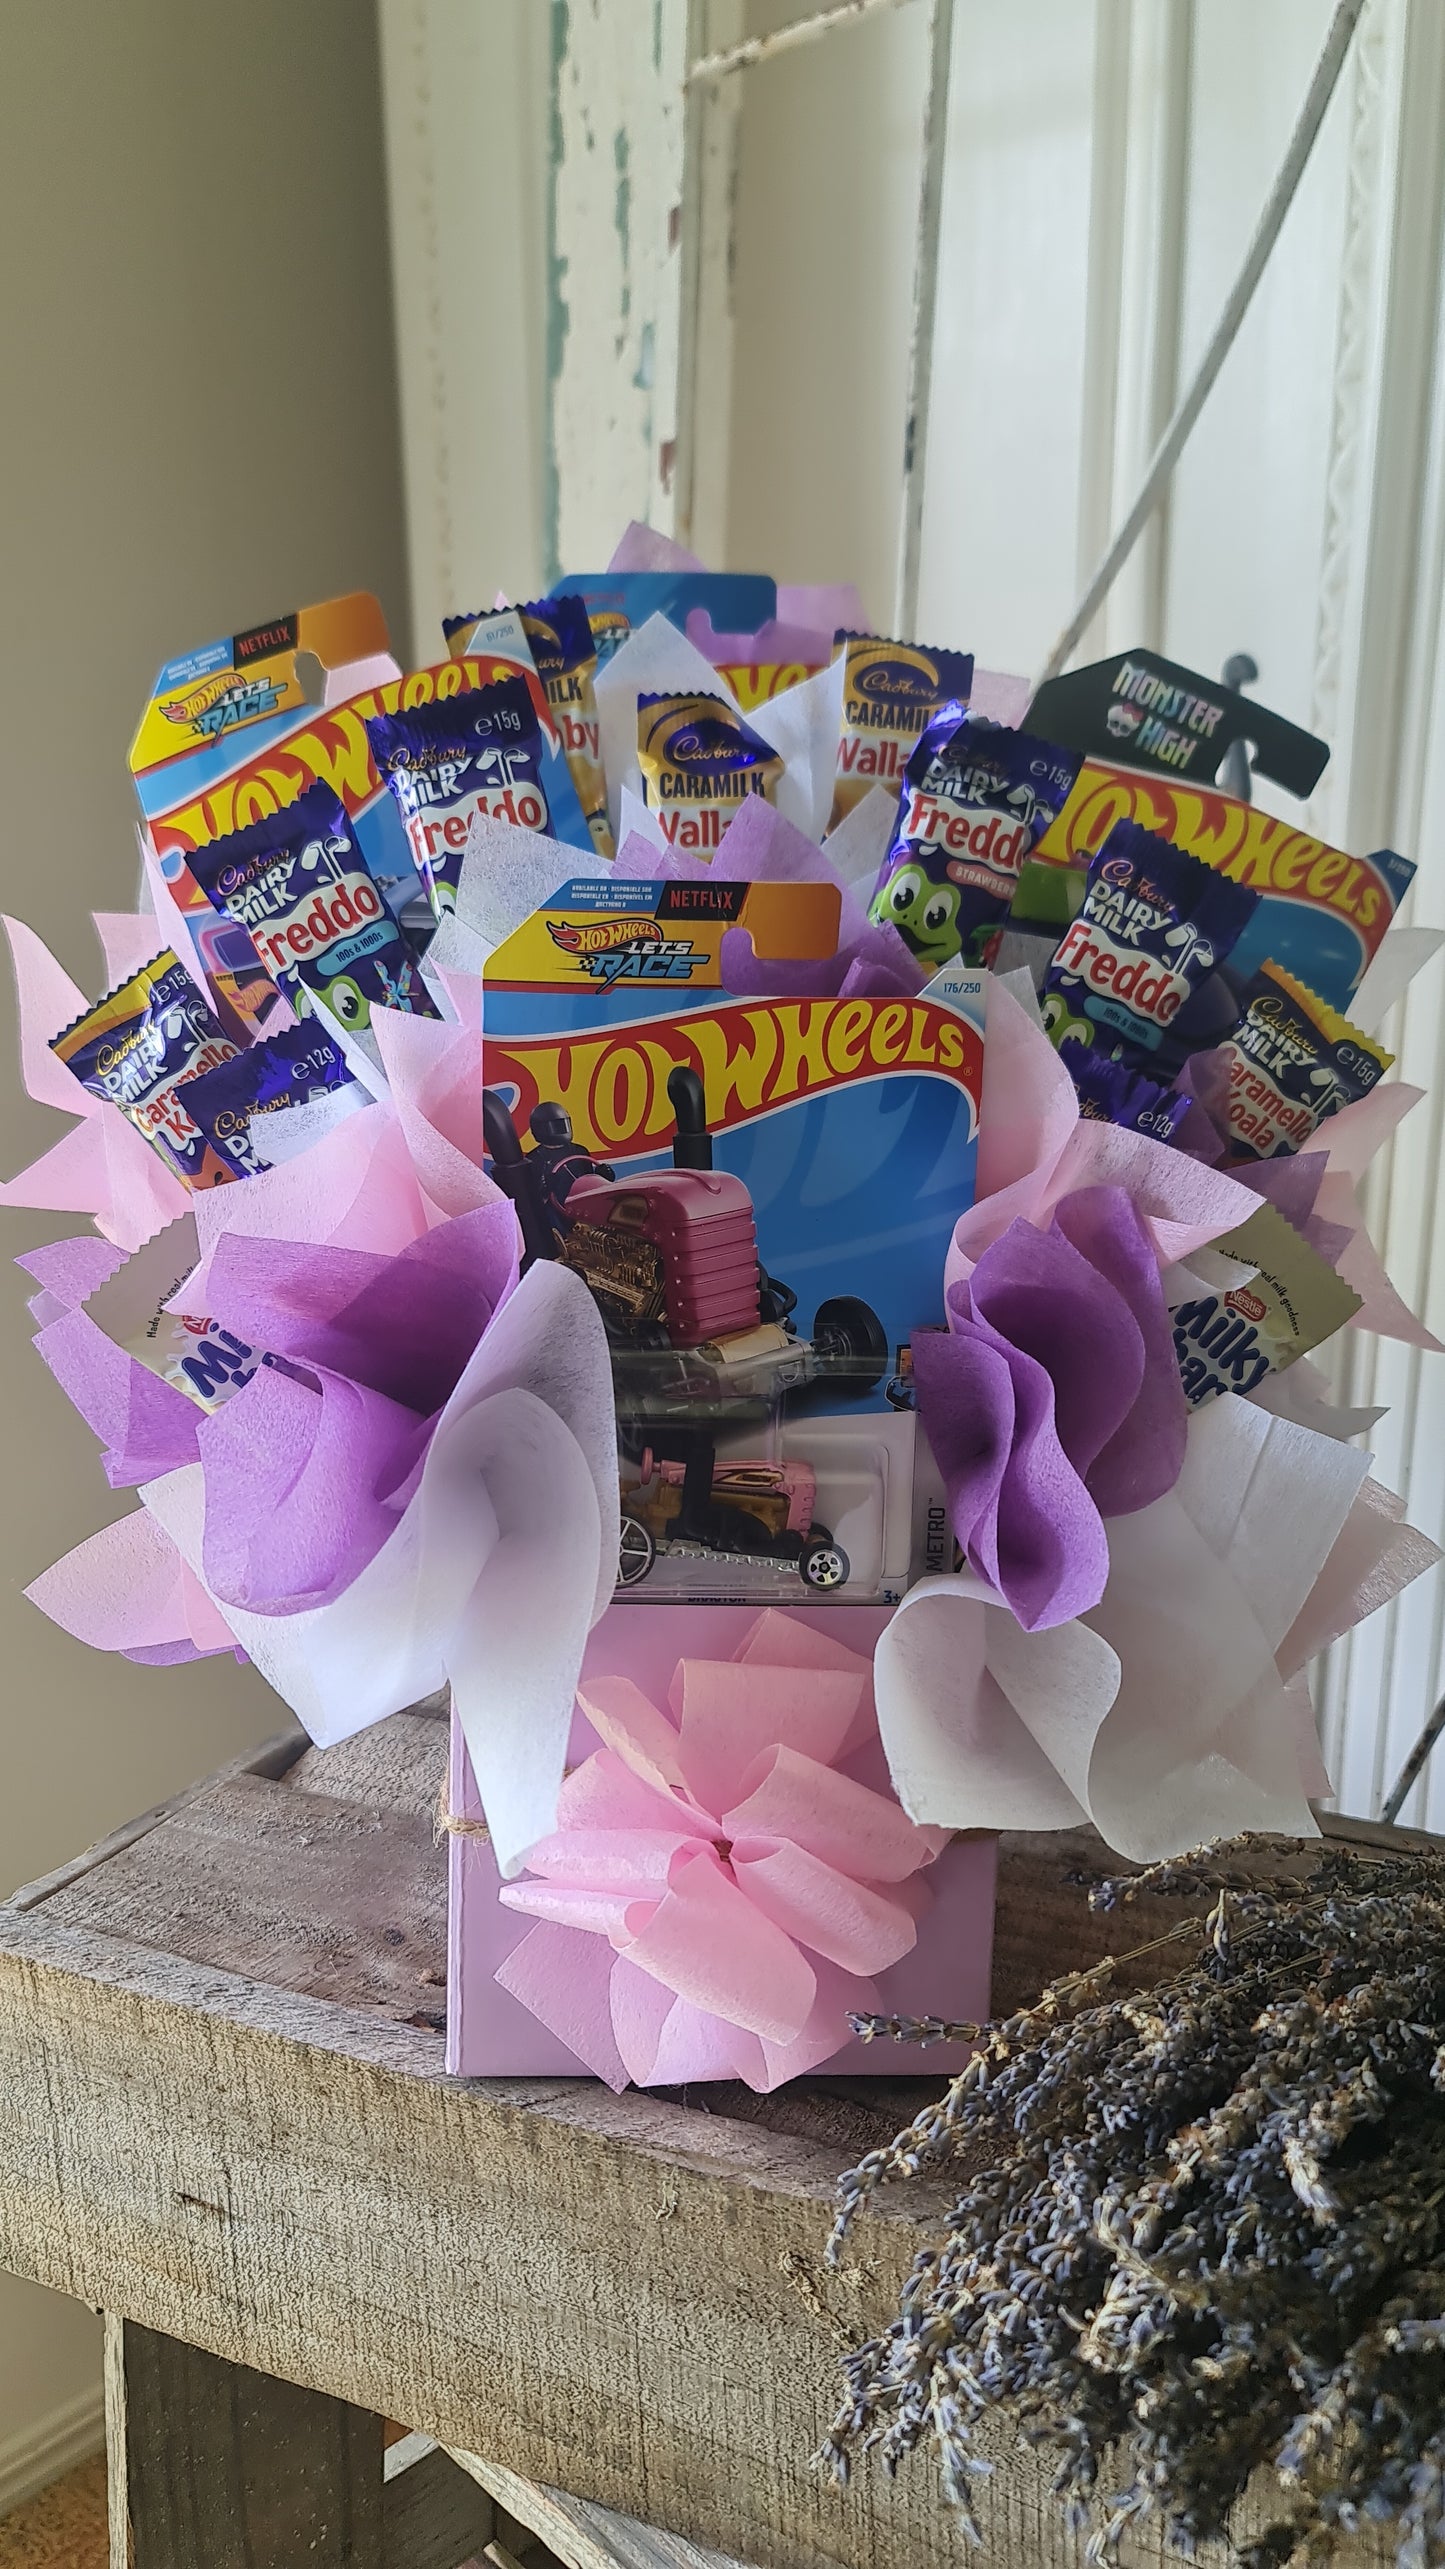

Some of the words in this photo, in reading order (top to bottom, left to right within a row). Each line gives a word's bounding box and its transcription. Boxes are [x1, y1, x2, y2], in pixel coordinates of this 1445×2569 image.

[239, 626, 292, 657] NETFLIX
[222, 678, 271, 706] LET'S
[862, 669, 937, 700] Cadbury
[1112, 660, 1226, 739] MONSTER
[199, 683, 289, 748] RACE
[846, 700, 929, 732] CARAMIL
[387, 744, 467, 772] Cadbury
[673, 736, 752, 764] Cadbury
[1135, 715, 1198, 770] HIGH
[400, 755, 473, 787] DAIRY
[660, 771, 767, 800] CARAMILK
[920, 775, 988, 806] MILK
[926, 757, 1011, 794] DAIRY
[402, 774, 465, 815] MILK
[907, 794, 1025, 872] Fredd
[216, 848, 291, 897] Cadbury
[226, 856, 298, 914] DAIRY
[236, 883, 299, 926] MILK
[670, 889, 734, 910] NETFLIX
[1090, 878, 1173, 931] DAIRY
[251, 883, 380, 974] Freddo
[576, 929, 609, 951] HOT
[1082, 897, 1140, 947] MILK
[335, 947, 355, 964] 100s
[360, 932, 384, 950] 1000s
[627, 941, 693, 955] LET'S
[590, 954, 710, 994] RACE
[944, 981, 981, 995] 176/250
[1055, 923, 1182, 1022] Freddo
[1231, 1023, 1293, 1079] MILK
[1246, 1008, 1318, 1067] DAIRY
[103, 1040, 160, 1092] DAIR
[497, 1037, 692, 1152] HOT
[1228, 1060, 1314, 1144] aramello
[1228, 1090, 1275, 1150] oala
[147, 1315, 161, 1339] Made
[1270, 1279, 1288, 1298] milk
[1279, 1296, 1300, 1337] goodness
[1174, 1296, 1270, 1396] Milky
[926, 1506, 946, 1573] METRO
[883, 1589, 901, 1605] 3+
